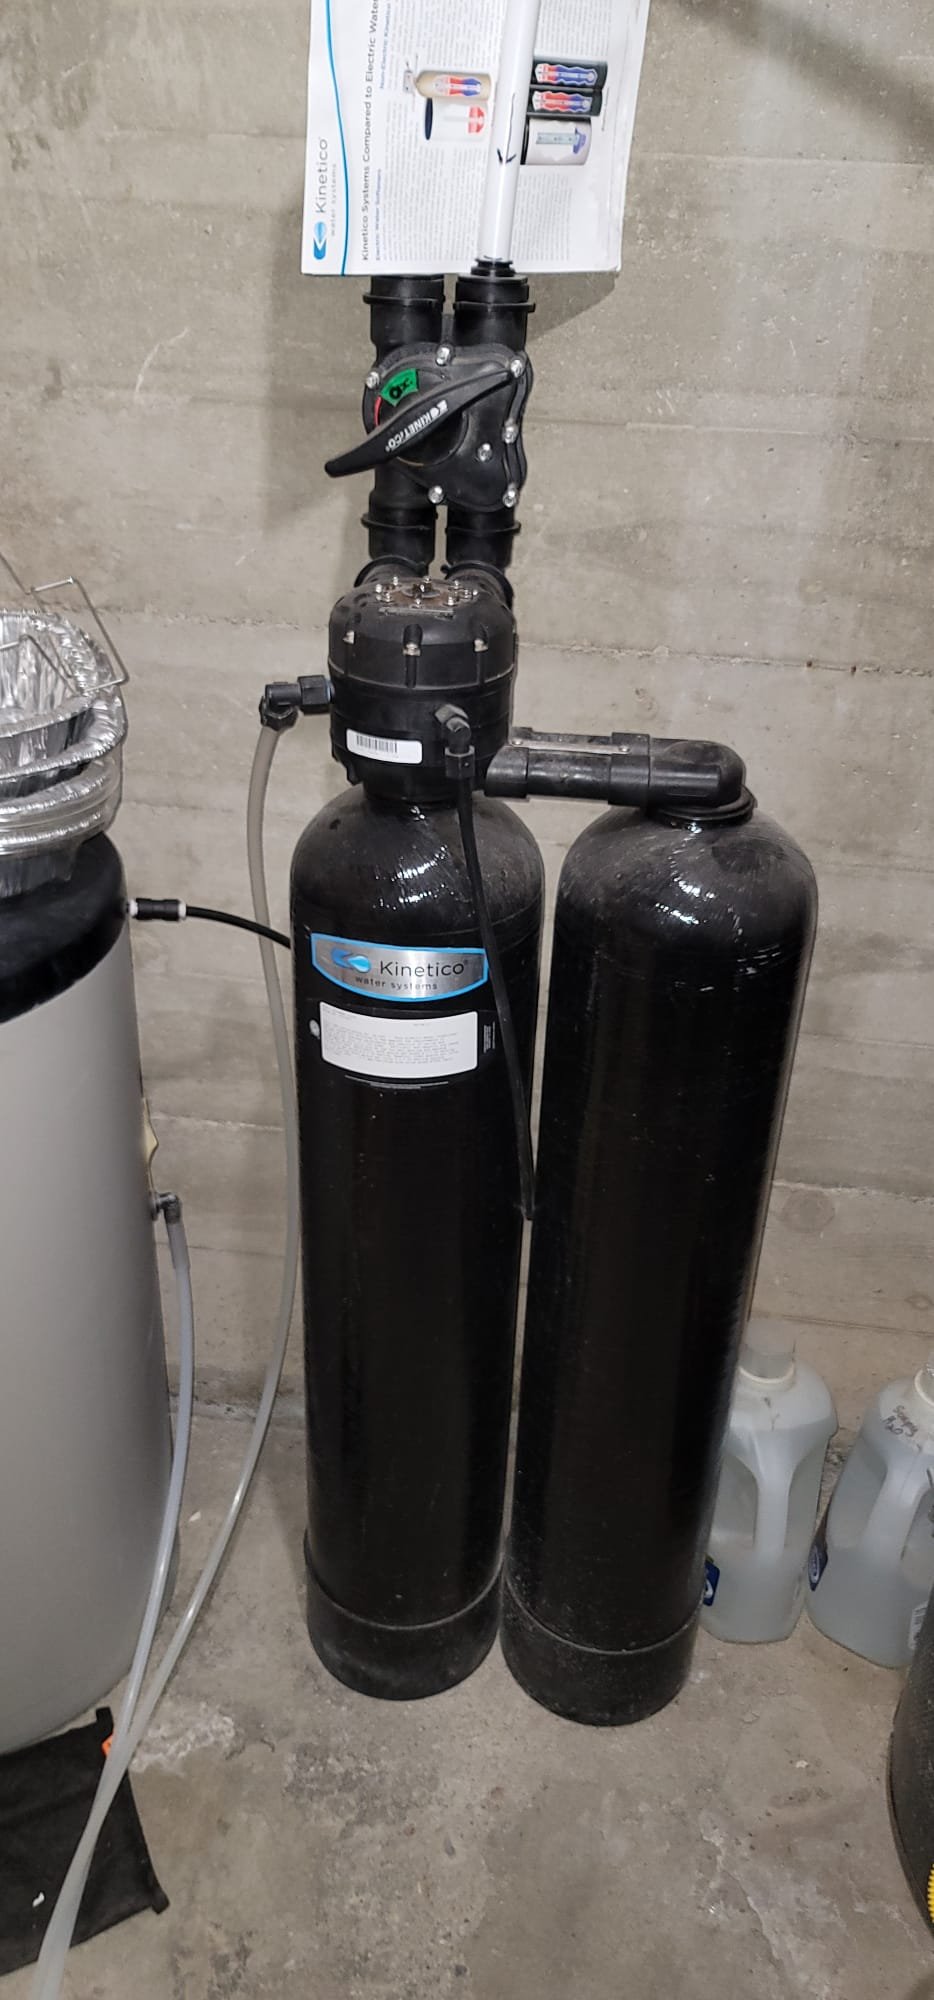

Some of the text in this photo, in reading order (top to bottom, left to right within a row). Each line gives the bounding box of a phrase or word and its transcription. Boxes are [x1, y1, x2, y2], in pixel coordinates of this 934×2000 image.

[366, 37, 376, 82] Electric
[365, 85, 373, 98] to
[363, 101, 372, 163] Compared
[315, 138, 328, 213] Kinetico
[362, 166, 371, 212] Systems
[361, 215, 369, 261] Kinetico
[355, 976, 438, 991] water systems
[380, 960, 465, 977] Kinetico
